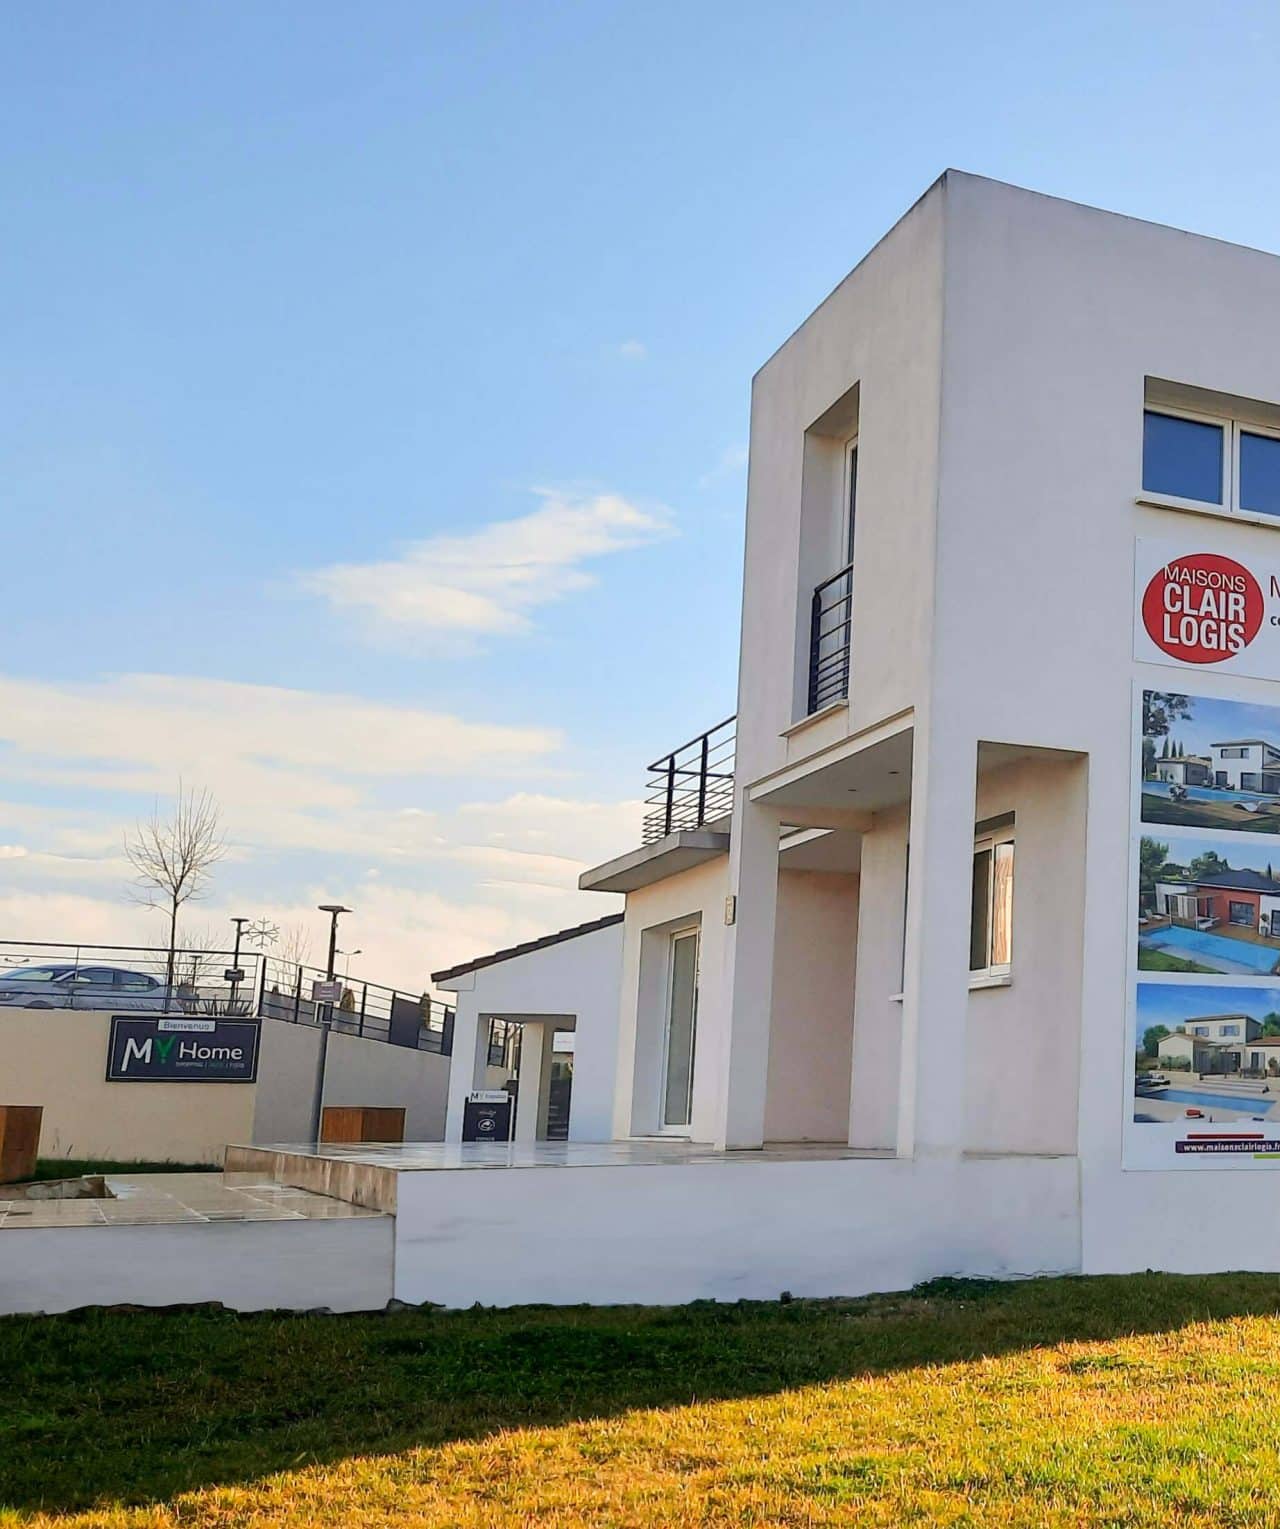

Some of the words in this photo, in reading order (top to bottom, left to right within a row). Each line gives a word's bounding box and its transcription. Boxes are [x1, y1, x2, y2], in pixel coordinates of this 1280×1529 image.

[1163, 565, 1247, 593] MAISONS
[1163, 582, 1246, 623] CLAIR
[1163, 613, 1246, 654] LOGIS
[121, 1034, 176, 1072] MY
[179, 1041, 243, 1060] Home
[1183, 1142, 1280, 1153] www.maisonsclairlogis.fr
